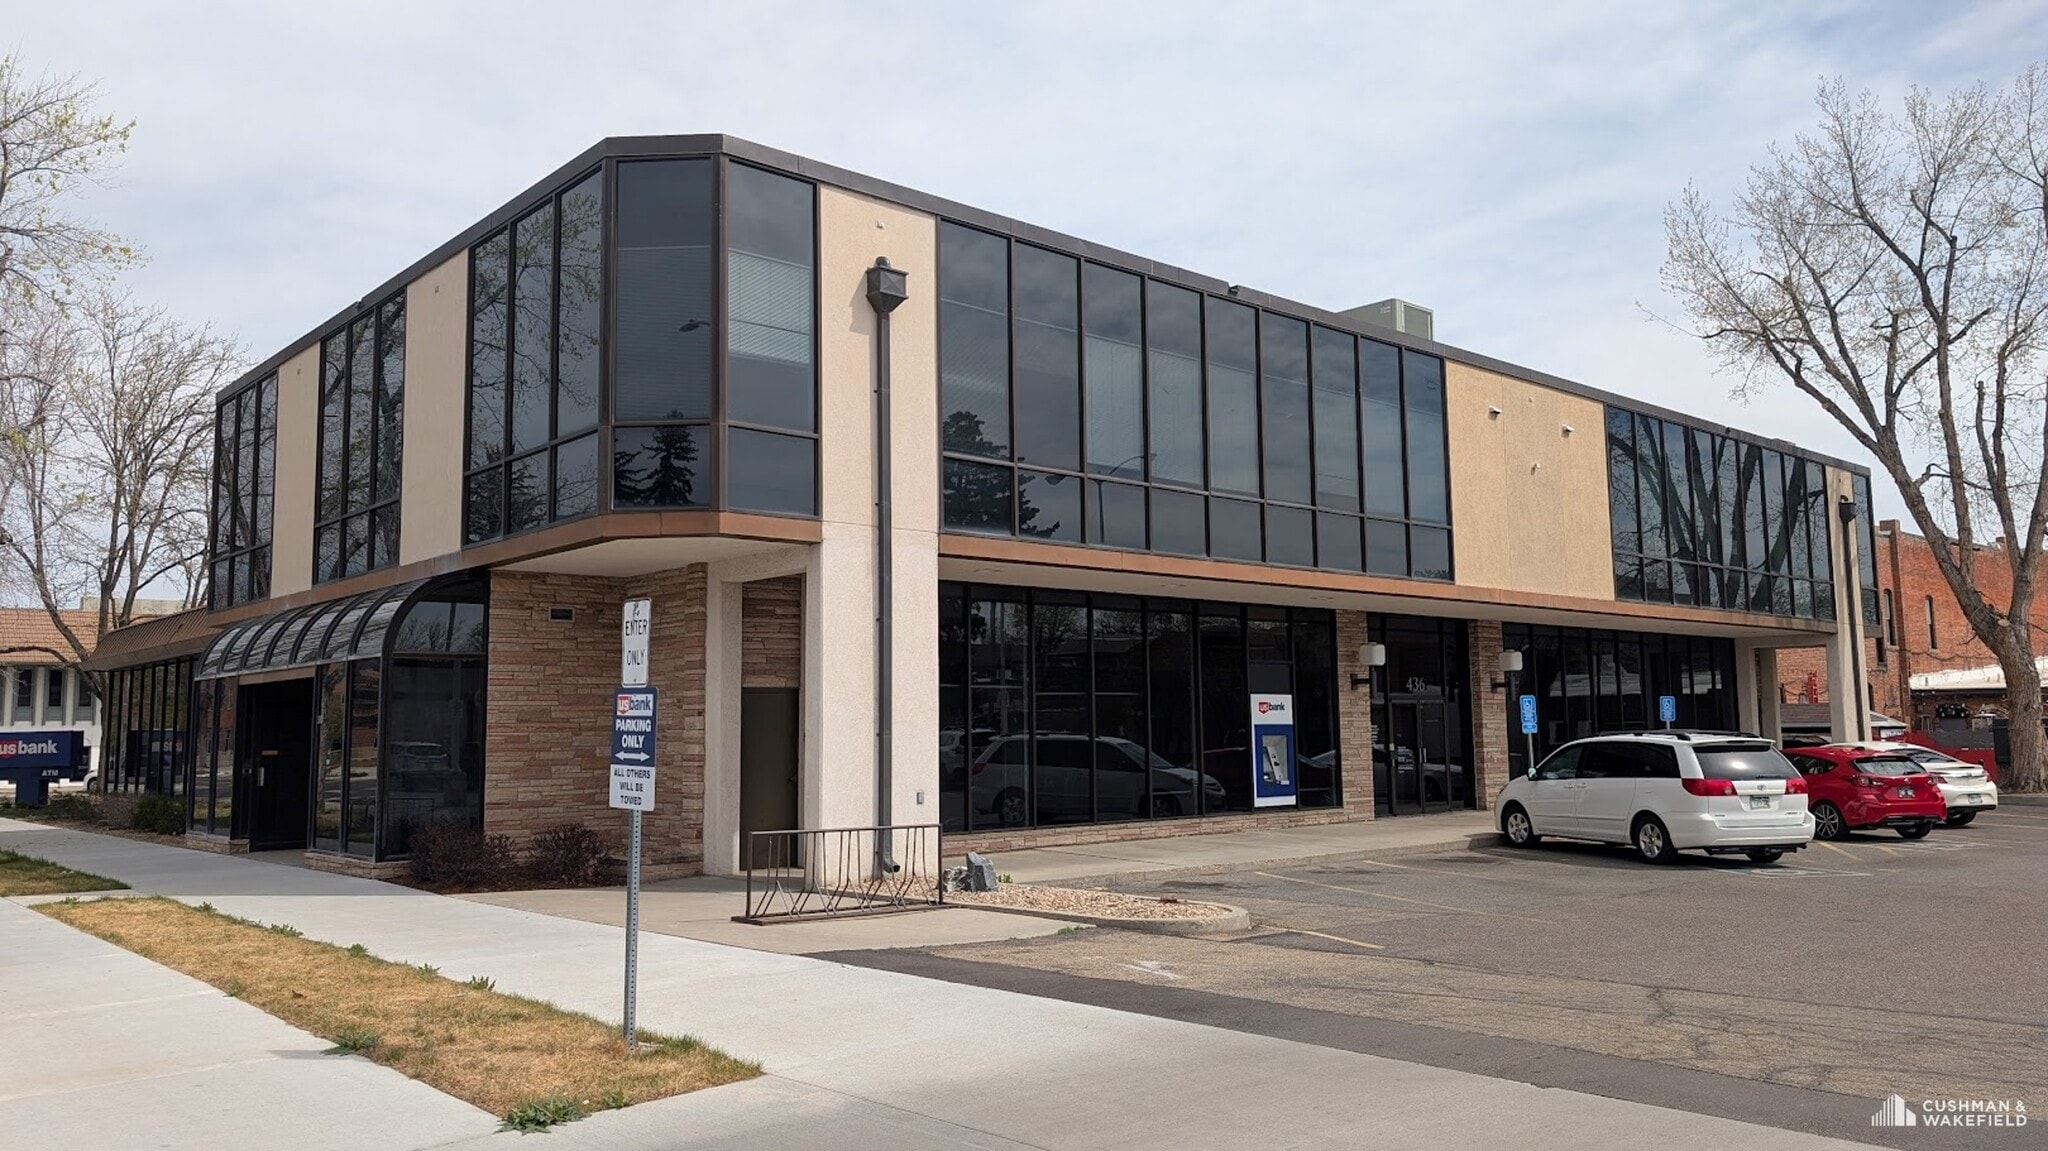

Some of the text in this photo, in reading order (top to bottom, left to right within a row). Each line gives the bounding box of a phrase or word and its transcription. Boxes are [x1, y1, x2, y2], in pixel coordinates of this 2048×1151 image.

[625, 619, 648, 636] ENTER
[626, 649, 646, 666] ONLY
[1406, 677, 1426, 692] 436
[615, 719, 652, 732] PARKING
[621, 734, 645, 748] ONLY
[614, 768, 651, 779] ALL OTHERS
[619, 782, 644, 792] WILL BE
[620, 795, 642, 806] TOWED
